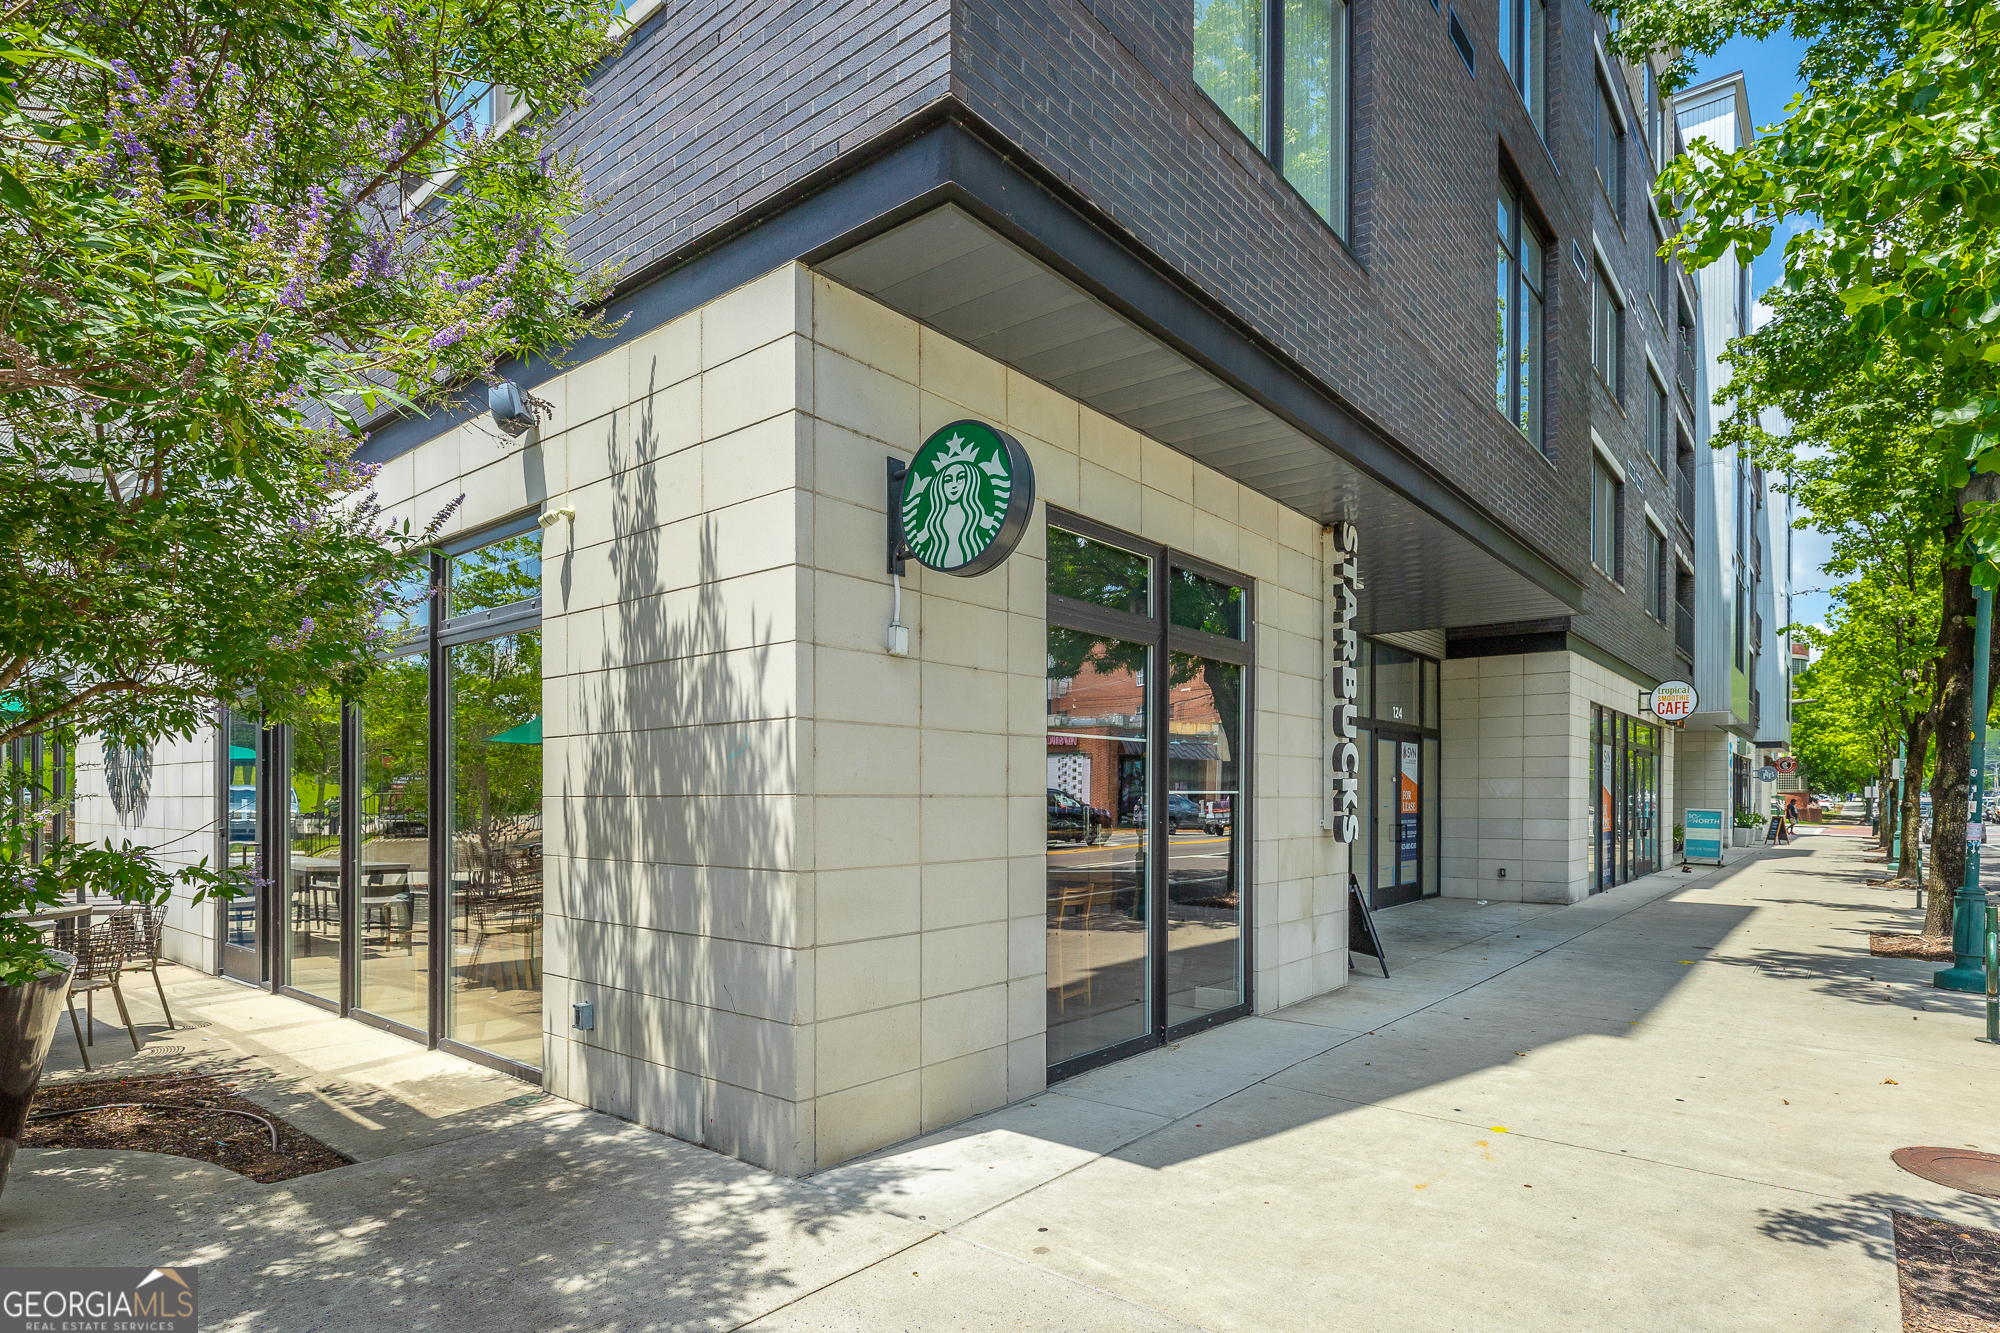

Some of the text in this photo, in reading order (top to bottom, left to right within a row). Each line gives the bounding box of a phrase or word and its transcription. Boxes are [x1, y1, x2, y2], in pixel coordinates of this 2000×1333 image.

[1336, 521, 1359, 843] STARBUCKS
[1657, 686, 1690, 695] tropical
[1392, 706, 1403, 719] 124
[1657, 701, 1690, 715] CAFE
[1402, 790, 1412, 800] FOR
[1402, 801, 1416, 812] LEASE
